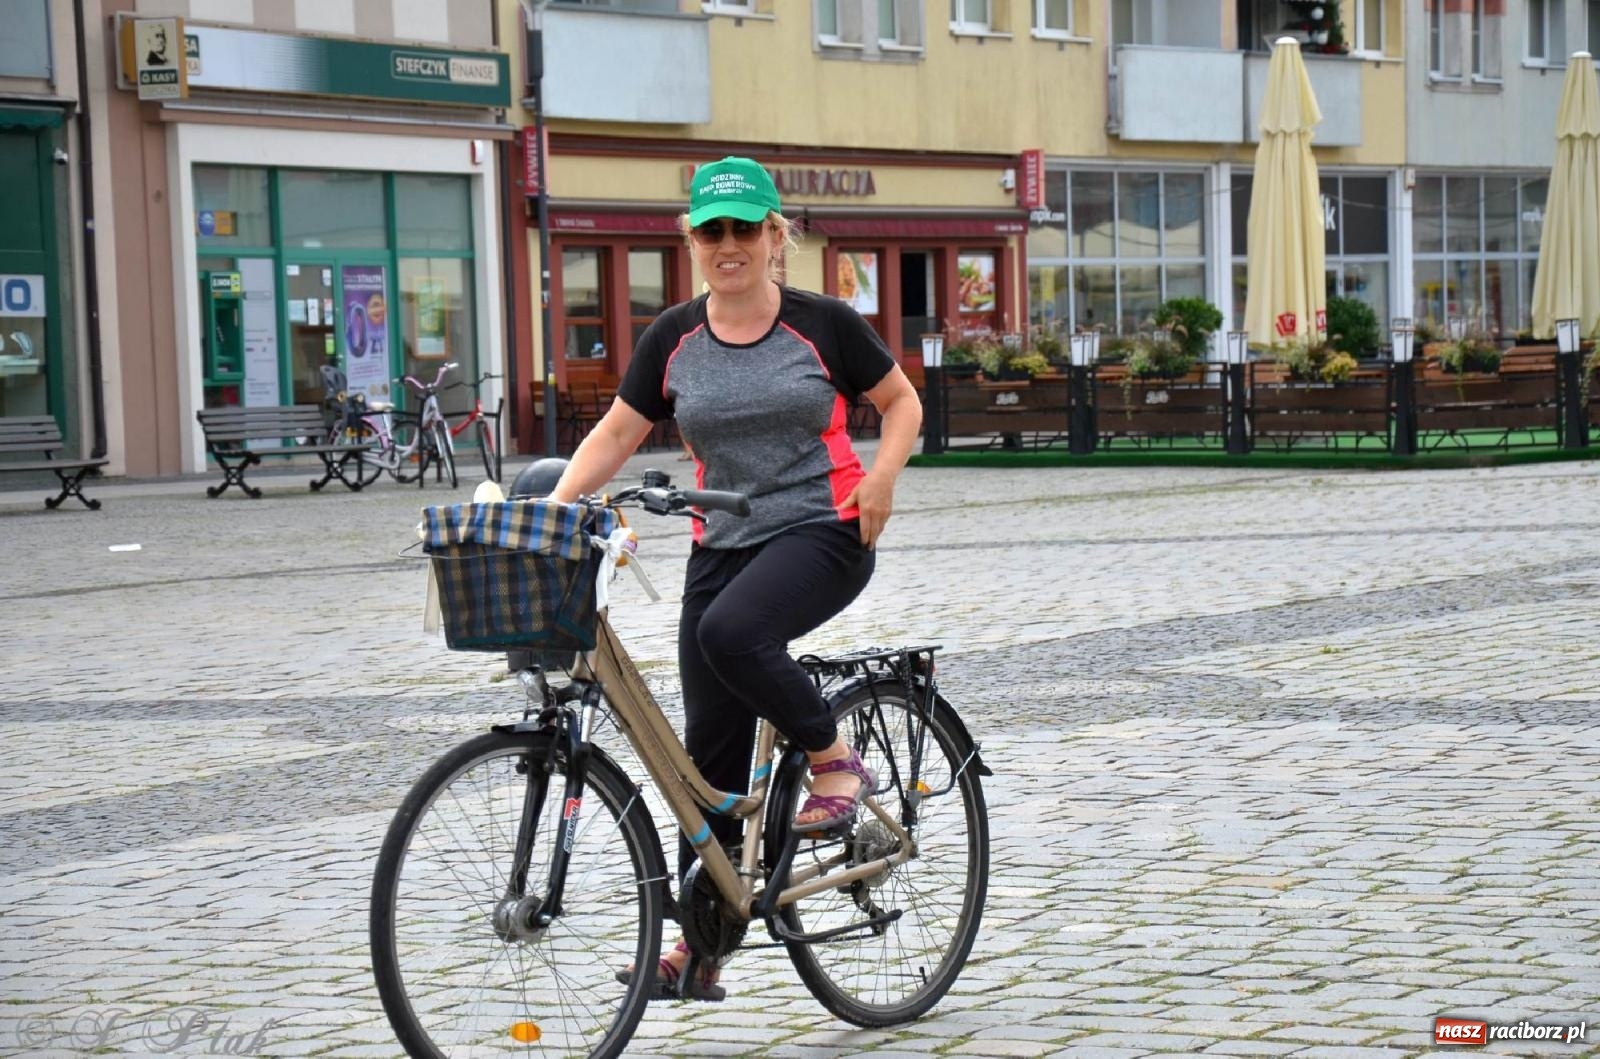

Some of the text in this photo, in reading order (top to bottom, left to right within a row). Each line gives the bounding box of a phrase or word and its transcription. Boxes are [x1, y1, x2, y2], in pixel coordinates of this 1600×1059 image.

[395, 57, 494, 81] STEFCZYK FINANSE
[151, 73, 176, 82] KASY
[710, 173, 744, 183] RODZINNY
